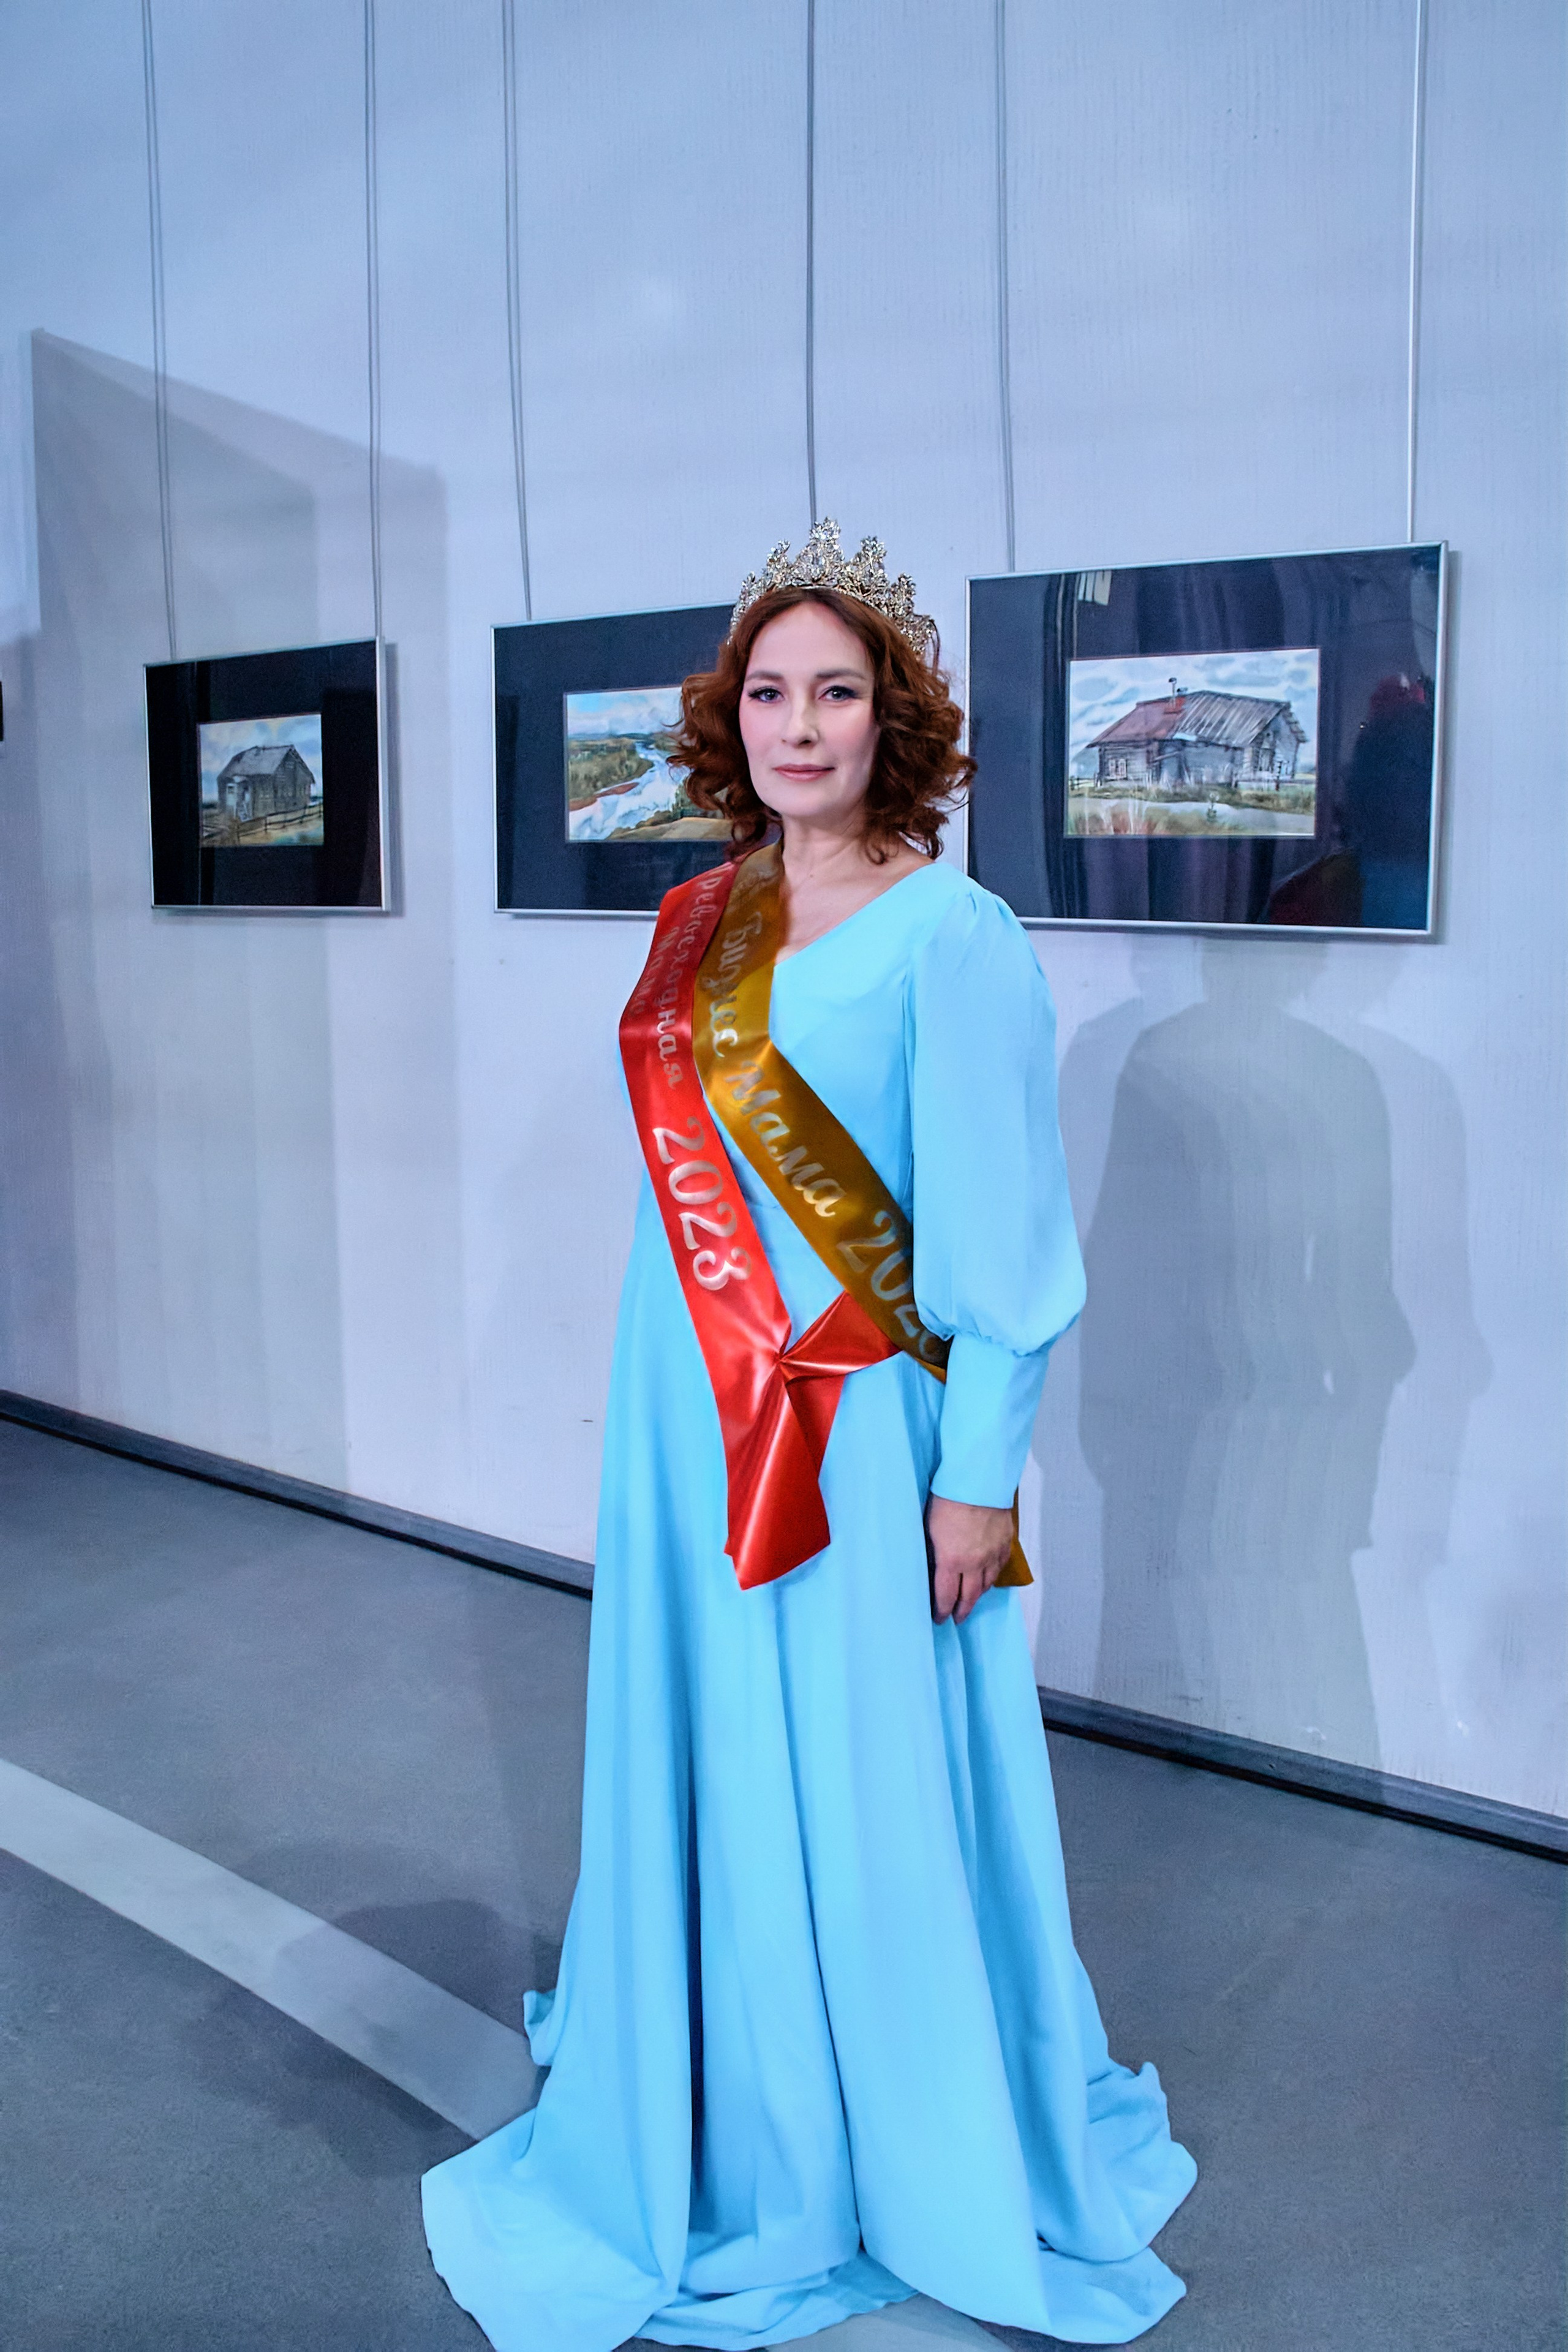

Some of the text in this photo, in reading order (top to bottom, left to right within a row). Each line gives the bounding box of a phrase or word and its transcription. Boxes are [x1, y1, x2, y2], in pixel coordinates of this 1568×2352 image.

[704, 911, 763, 1058] Бизнес
[652, 1117, 752, 1291] 2023
[725, 1060, 846, 1217] Мама
